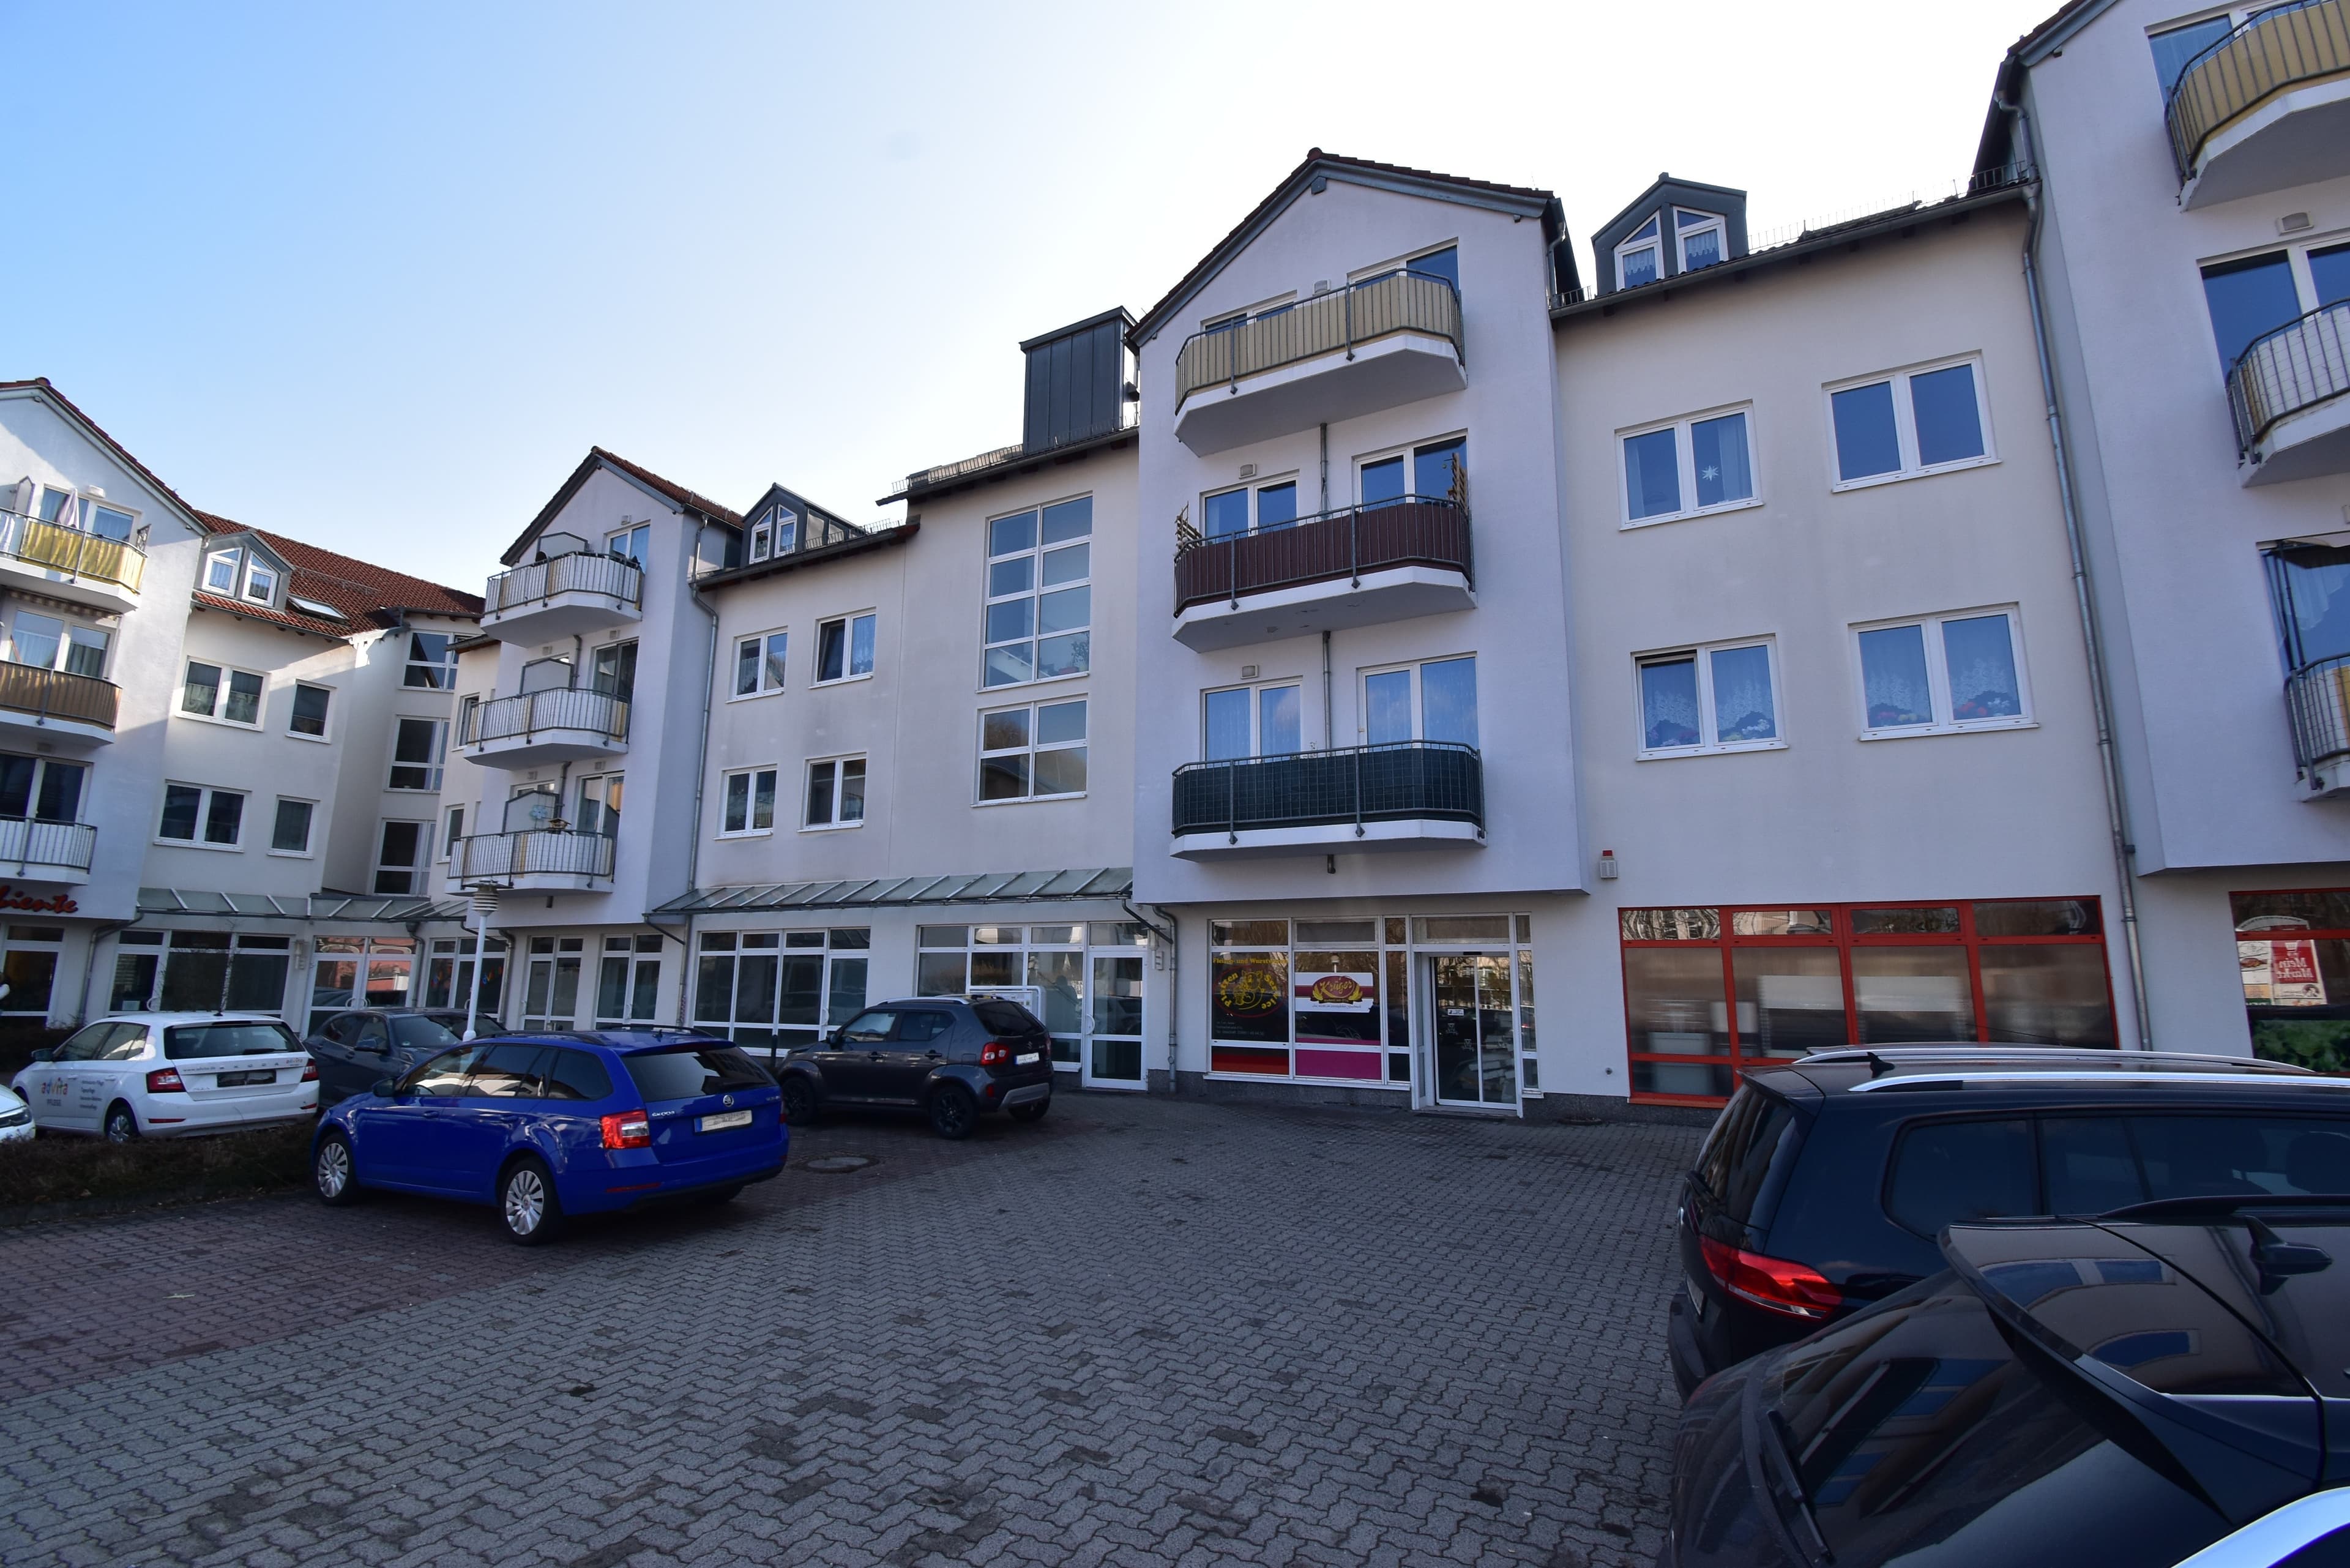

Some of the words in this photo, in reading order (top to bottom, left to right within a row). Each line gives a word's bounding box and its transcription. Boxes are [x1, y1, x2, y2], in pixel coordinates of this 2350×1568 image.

[1261, 974, 1279, 1009] Service
[1319, 980, 1354, 996] Krüger
[41, 1077, 69, 1095] advita
